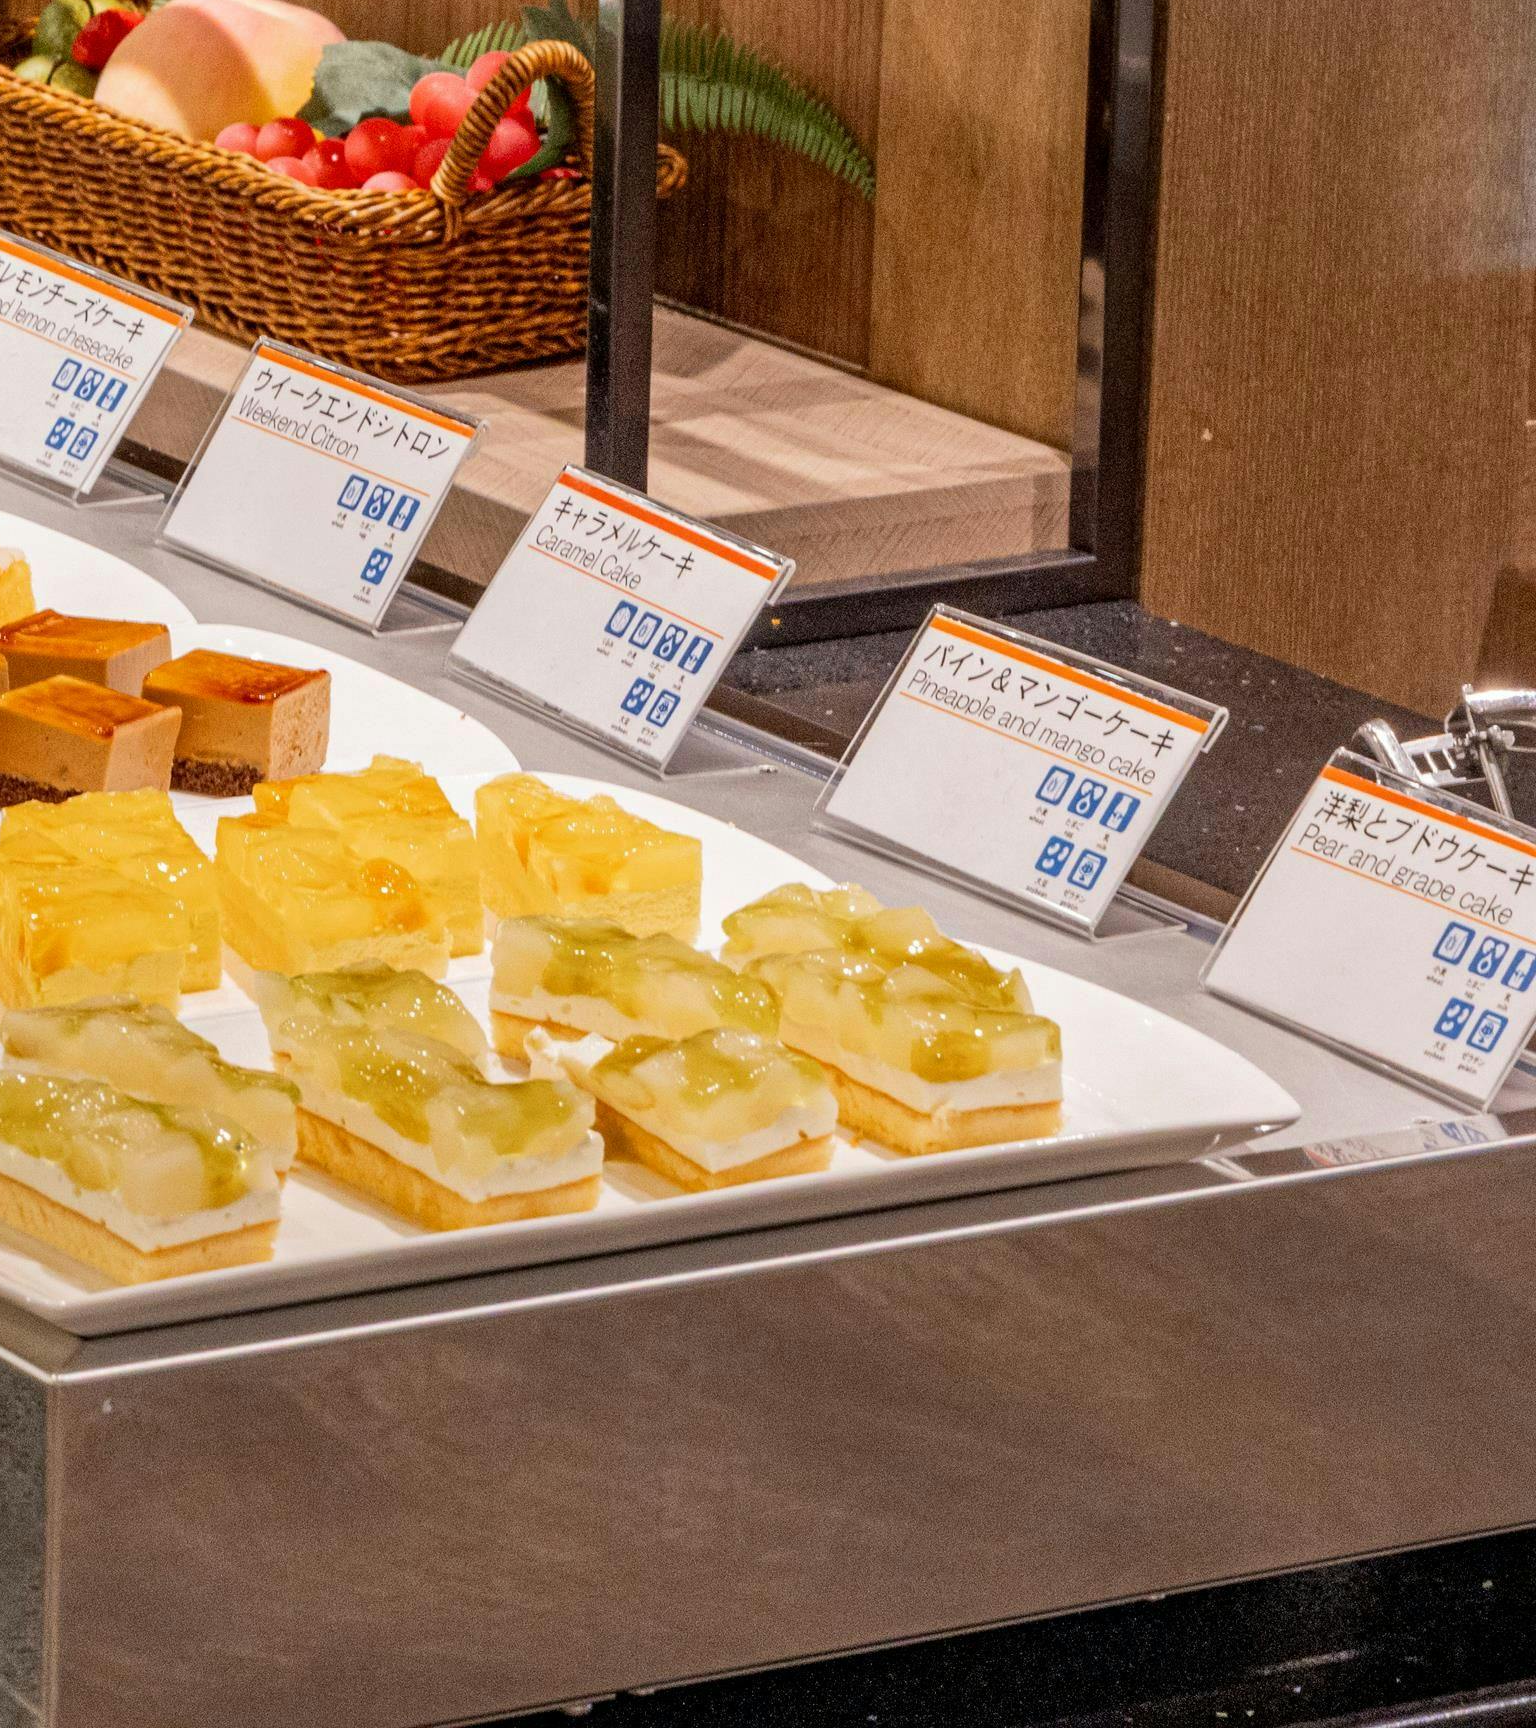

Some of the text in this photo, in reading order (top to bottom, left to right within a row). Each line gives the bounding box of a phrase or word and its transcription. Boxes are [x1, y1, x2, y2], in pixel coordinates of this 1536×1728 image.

[12, 300, 56, 337] lemon
[57, 324, 134, 370] chesecake
[239, 394, 359, 461] Weekend Citron
[254, 368, 450, 459] ウイークエンドシトロン
[536, 524, 642, 590] Caramel Cake
[554, 495, 695, 580] キャラメルケーキ
[907, 668, 1157, 786] Pineapple and mango cake
[1298, 822, 1513, 925] Pear and grape cake
[1314, 789, 1535, 896] 洋梨とブドウケーキ
